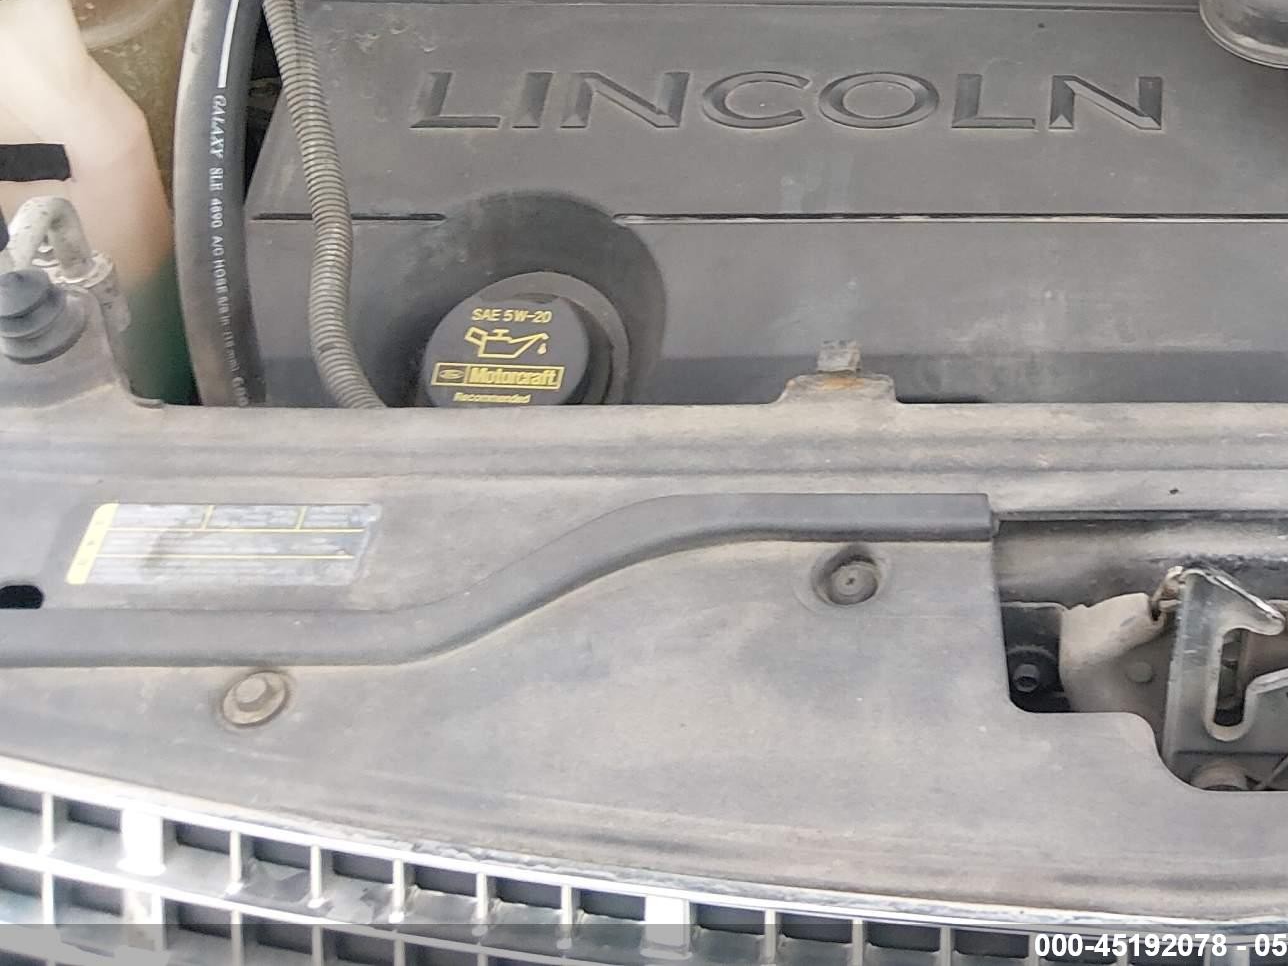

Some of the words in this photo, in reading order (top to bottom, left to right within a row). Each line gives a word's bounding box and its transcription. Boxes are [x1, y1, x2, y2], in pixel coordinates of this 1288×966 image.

[409, 70, 1164, 130] LINCOLN
[209, 94, 227, 159] GALAXY
[471, 308, 502, 321] SAE
[502, 309, 553, 324] 5W-20
[467, 366, 558, 386] Motorcraft
[452, 391, 532, 404] Recommended
